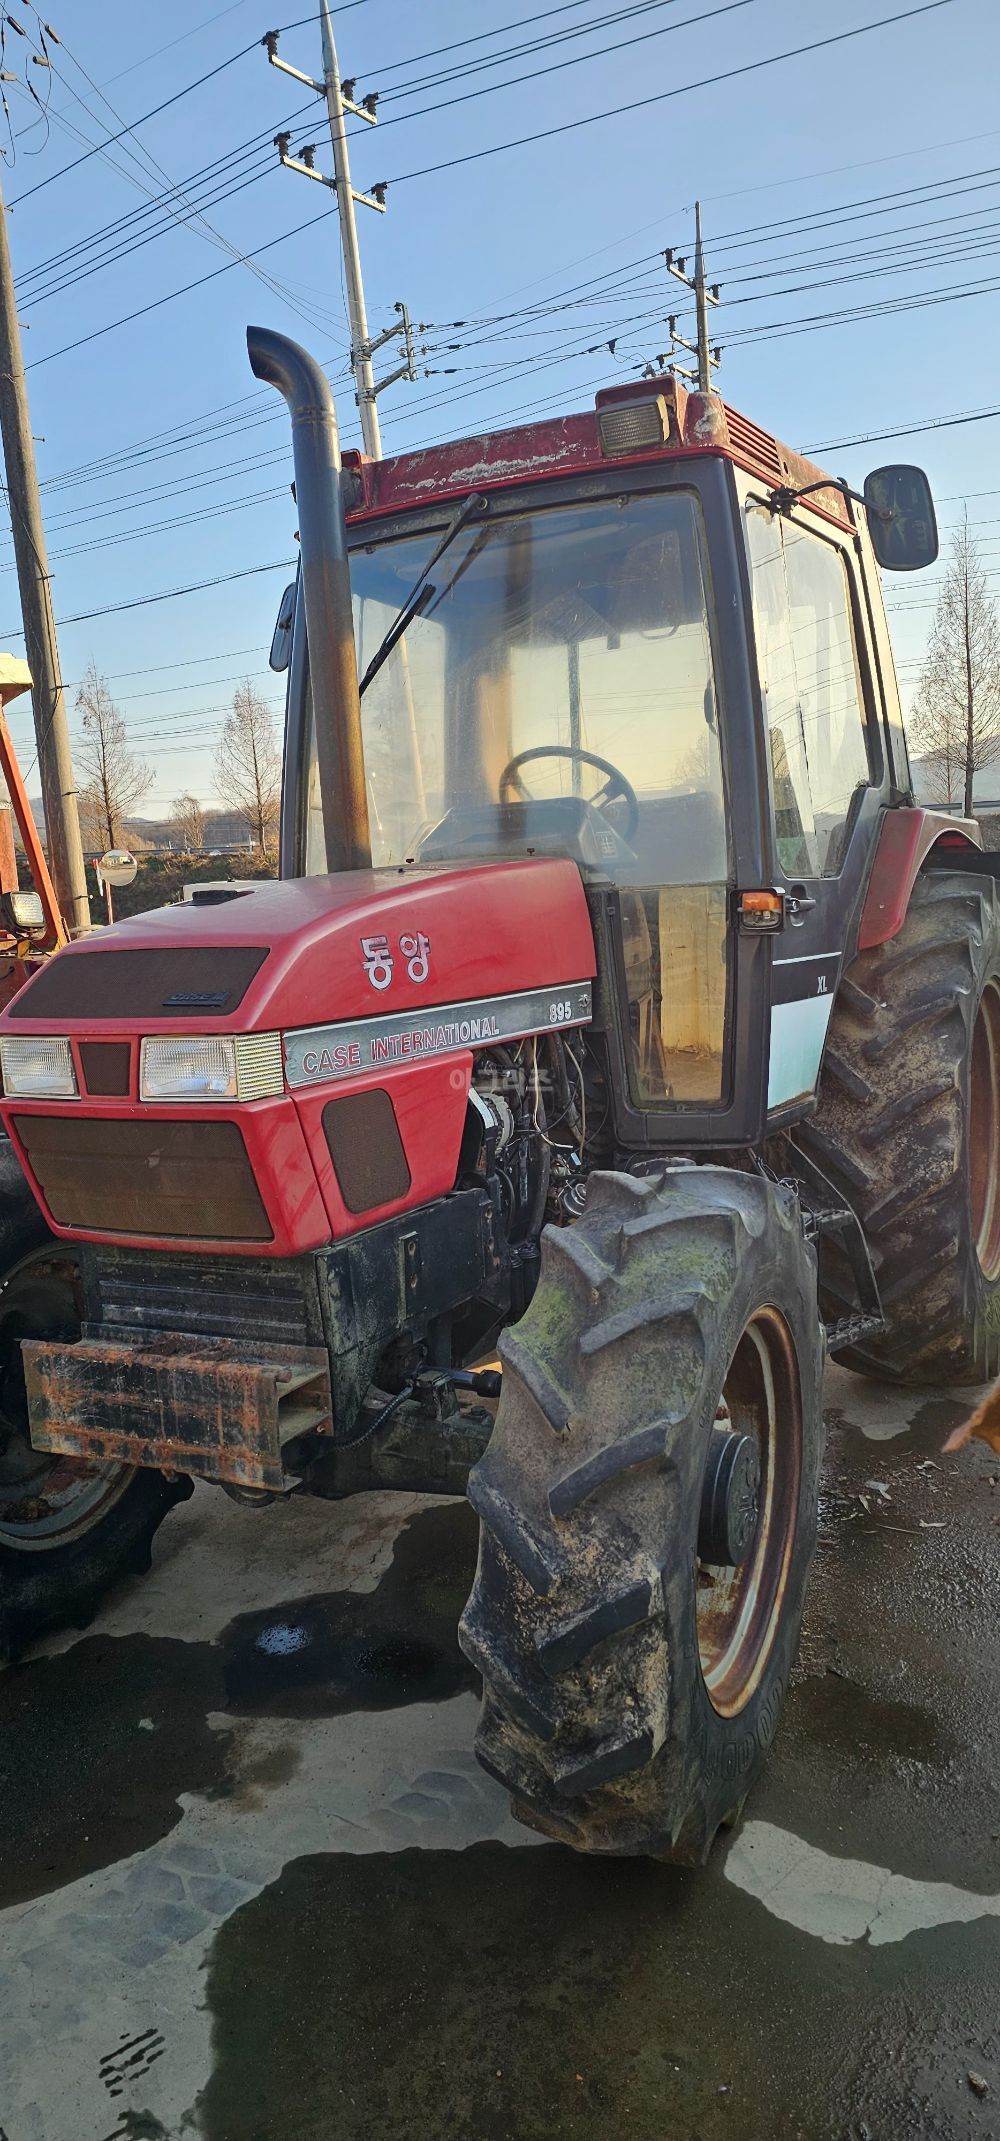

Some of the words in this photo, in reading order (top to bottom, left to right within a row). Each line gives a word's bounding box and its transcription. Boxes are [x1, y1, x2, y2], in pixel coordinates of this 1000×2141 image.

[360, 931, 430, 990] 동양
[817, 975, 828, 993] XL
[549, 1001, 572, 1022] 895
[302, 1042, 361, 1076] CASE
[370, 1015, 500, 1062] INTERNATIONAL
